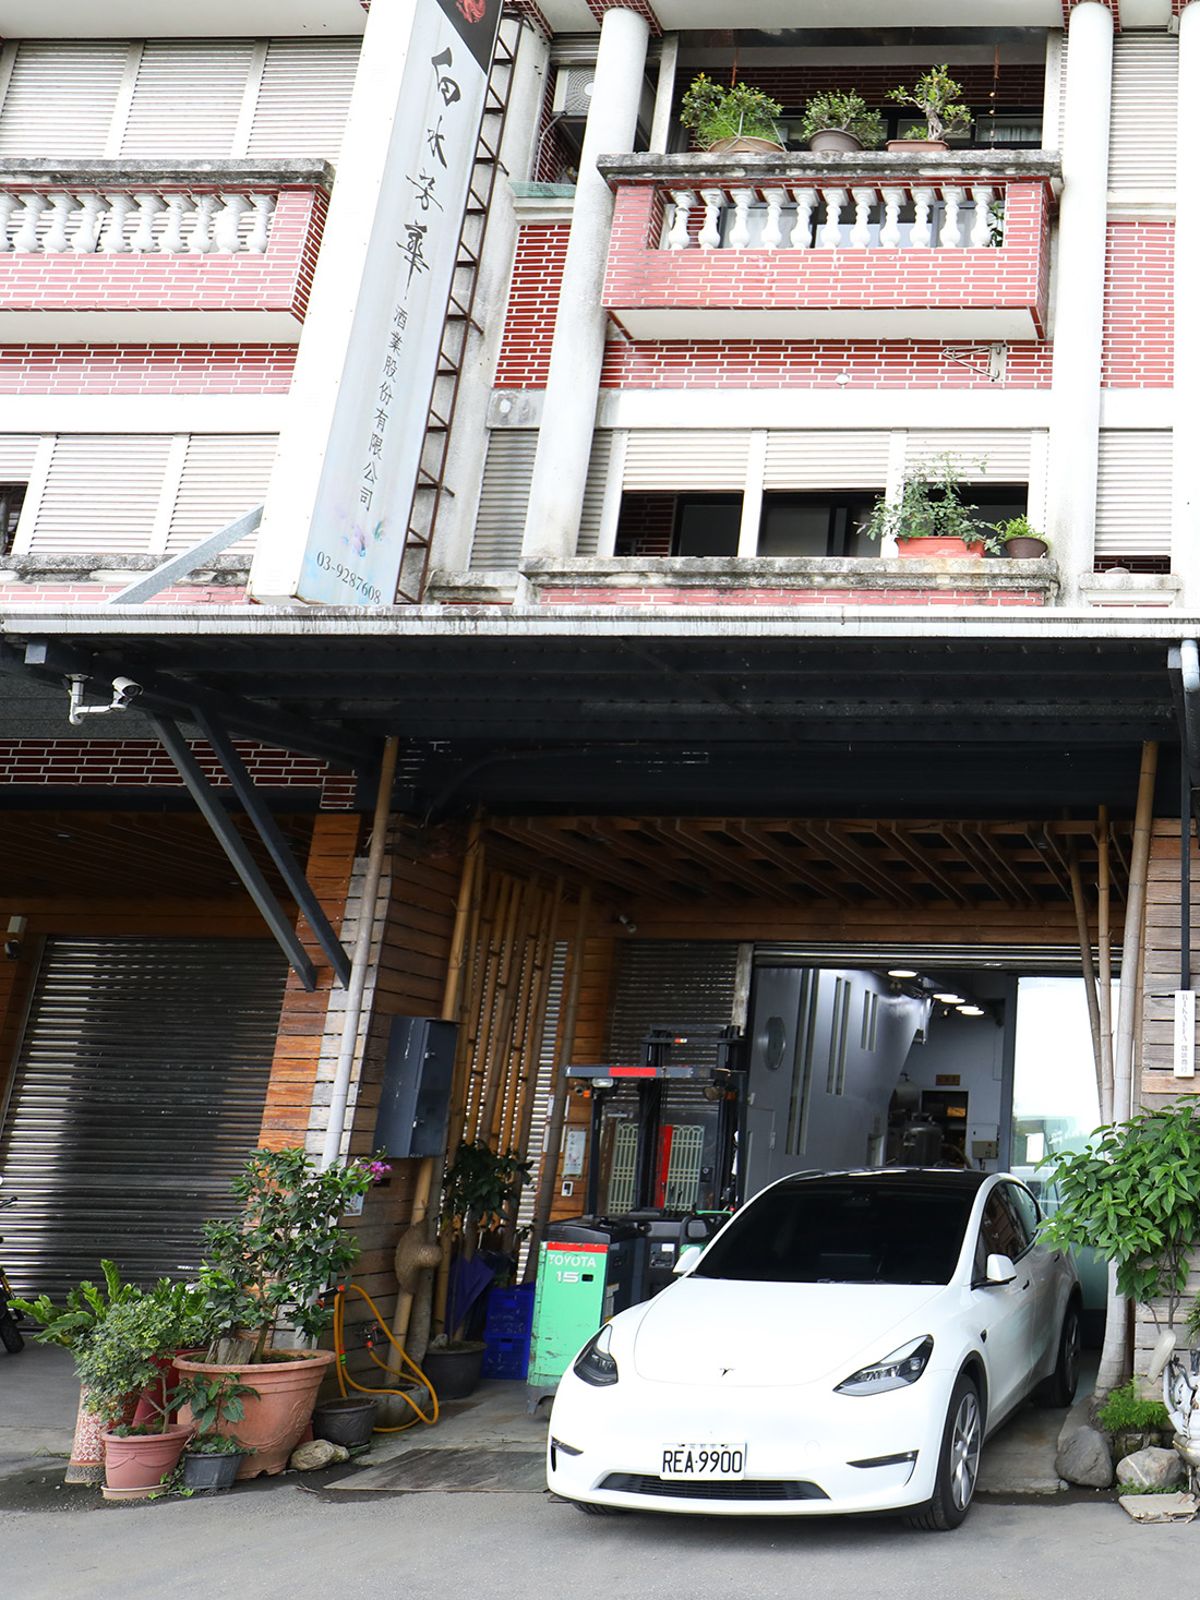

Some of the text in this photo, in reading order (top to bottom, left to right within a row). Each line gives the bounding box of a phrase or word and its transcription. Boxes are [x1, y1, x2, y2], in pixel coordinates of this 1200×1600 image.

[360, 306, 409, 511] 酒業股份有限公司
[316, 551, 382, 604] 03-9287608
[549, 1254, 597, 1268] TOYOTA
